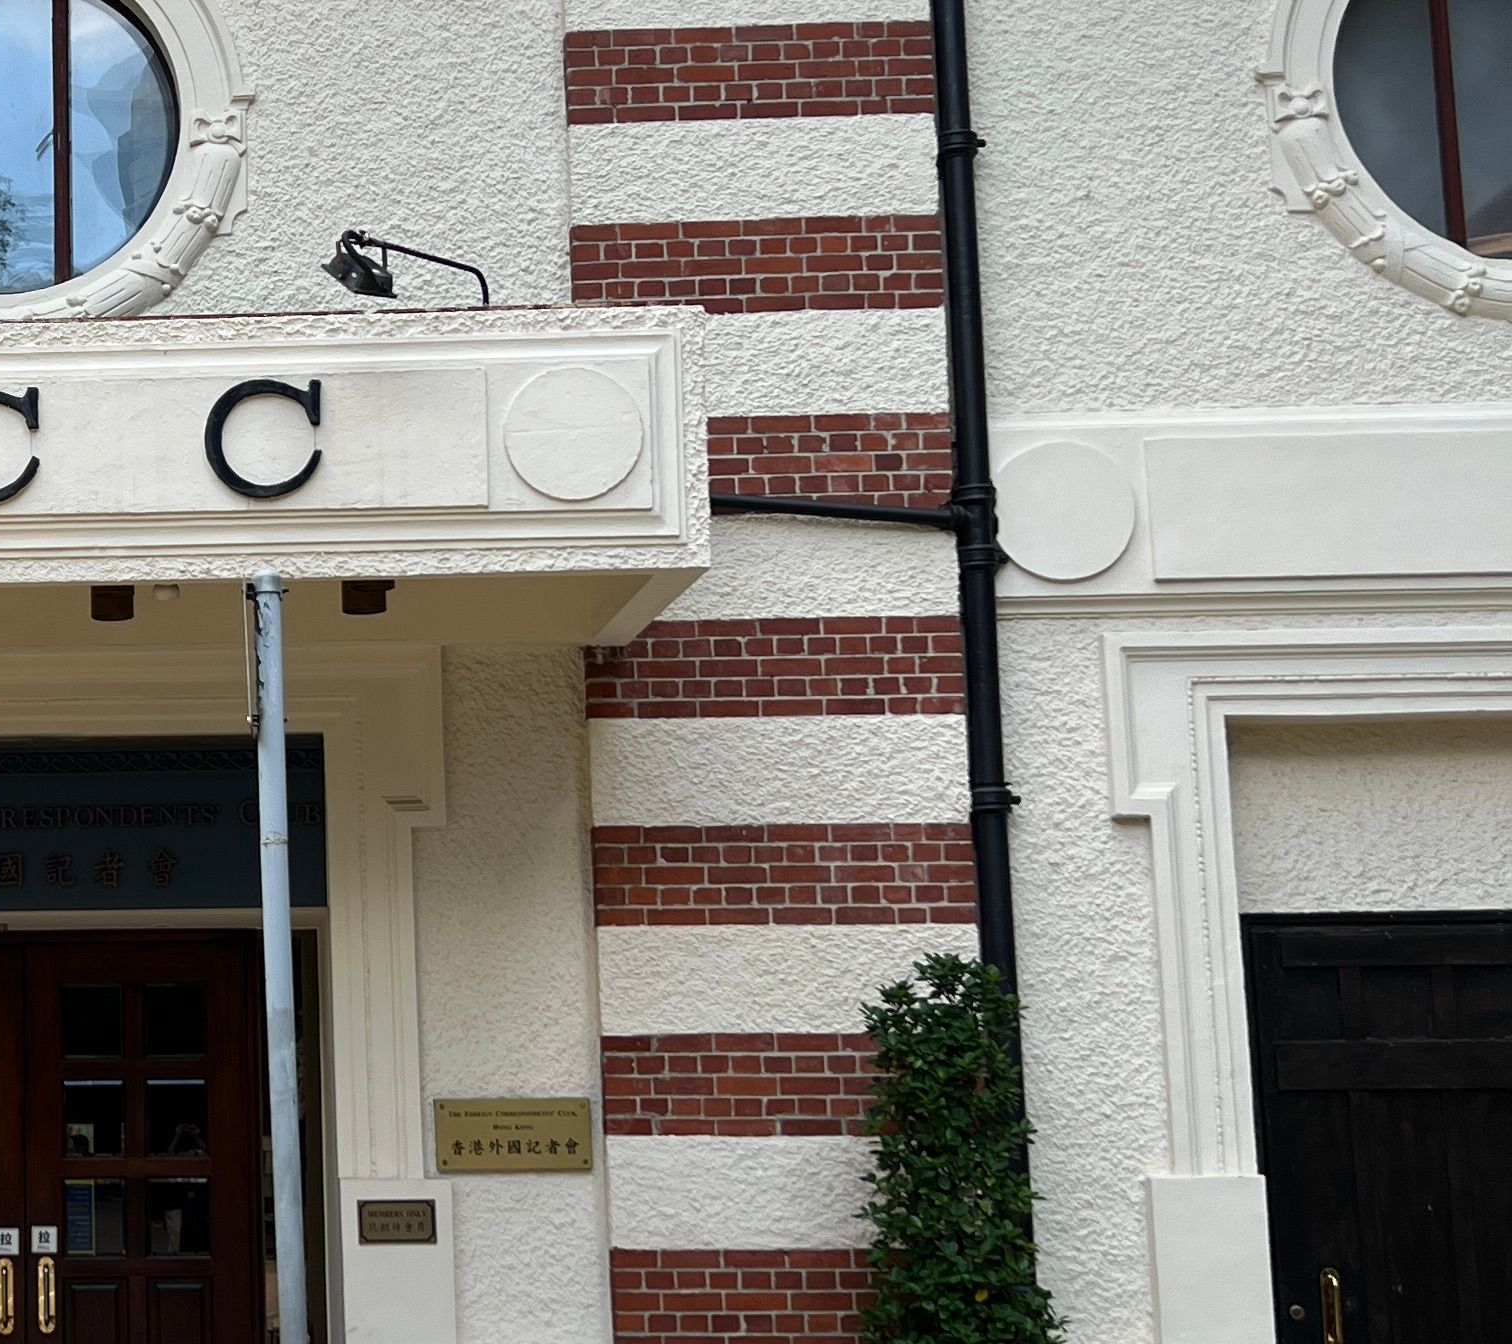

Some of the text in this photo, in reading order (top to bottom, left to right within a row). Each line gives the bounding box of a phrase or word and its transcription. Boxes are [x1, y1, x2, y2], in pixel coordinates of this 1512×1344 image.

[451, 1138, 580, 1156] 香港外國記者會
